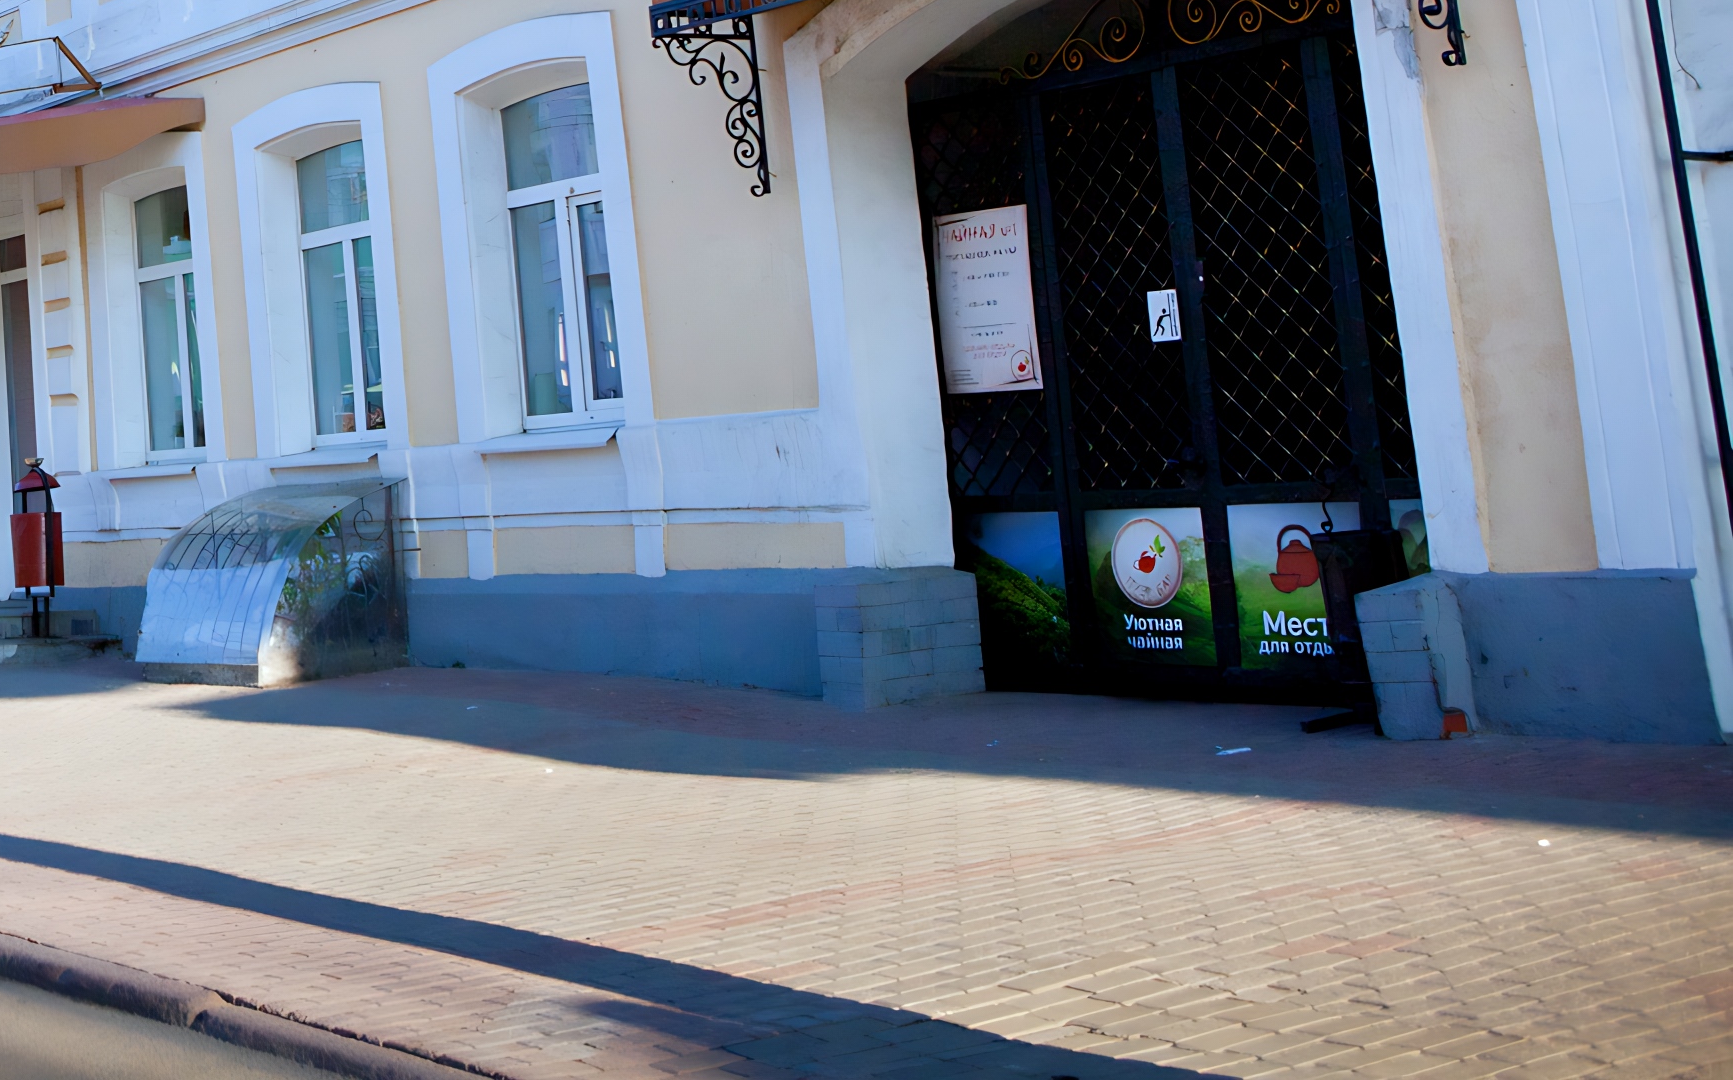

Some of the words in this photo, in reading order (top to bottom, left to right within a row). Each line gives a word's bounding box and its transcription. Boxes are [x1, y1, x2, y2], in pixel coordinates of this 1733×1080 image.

[1124, 614, 1183, 631] Уютная
[1263, 610, 1328, 637] Мест
[1128, 633, 1183, 649] чайная
[1259, 640, 1289, 656] для
